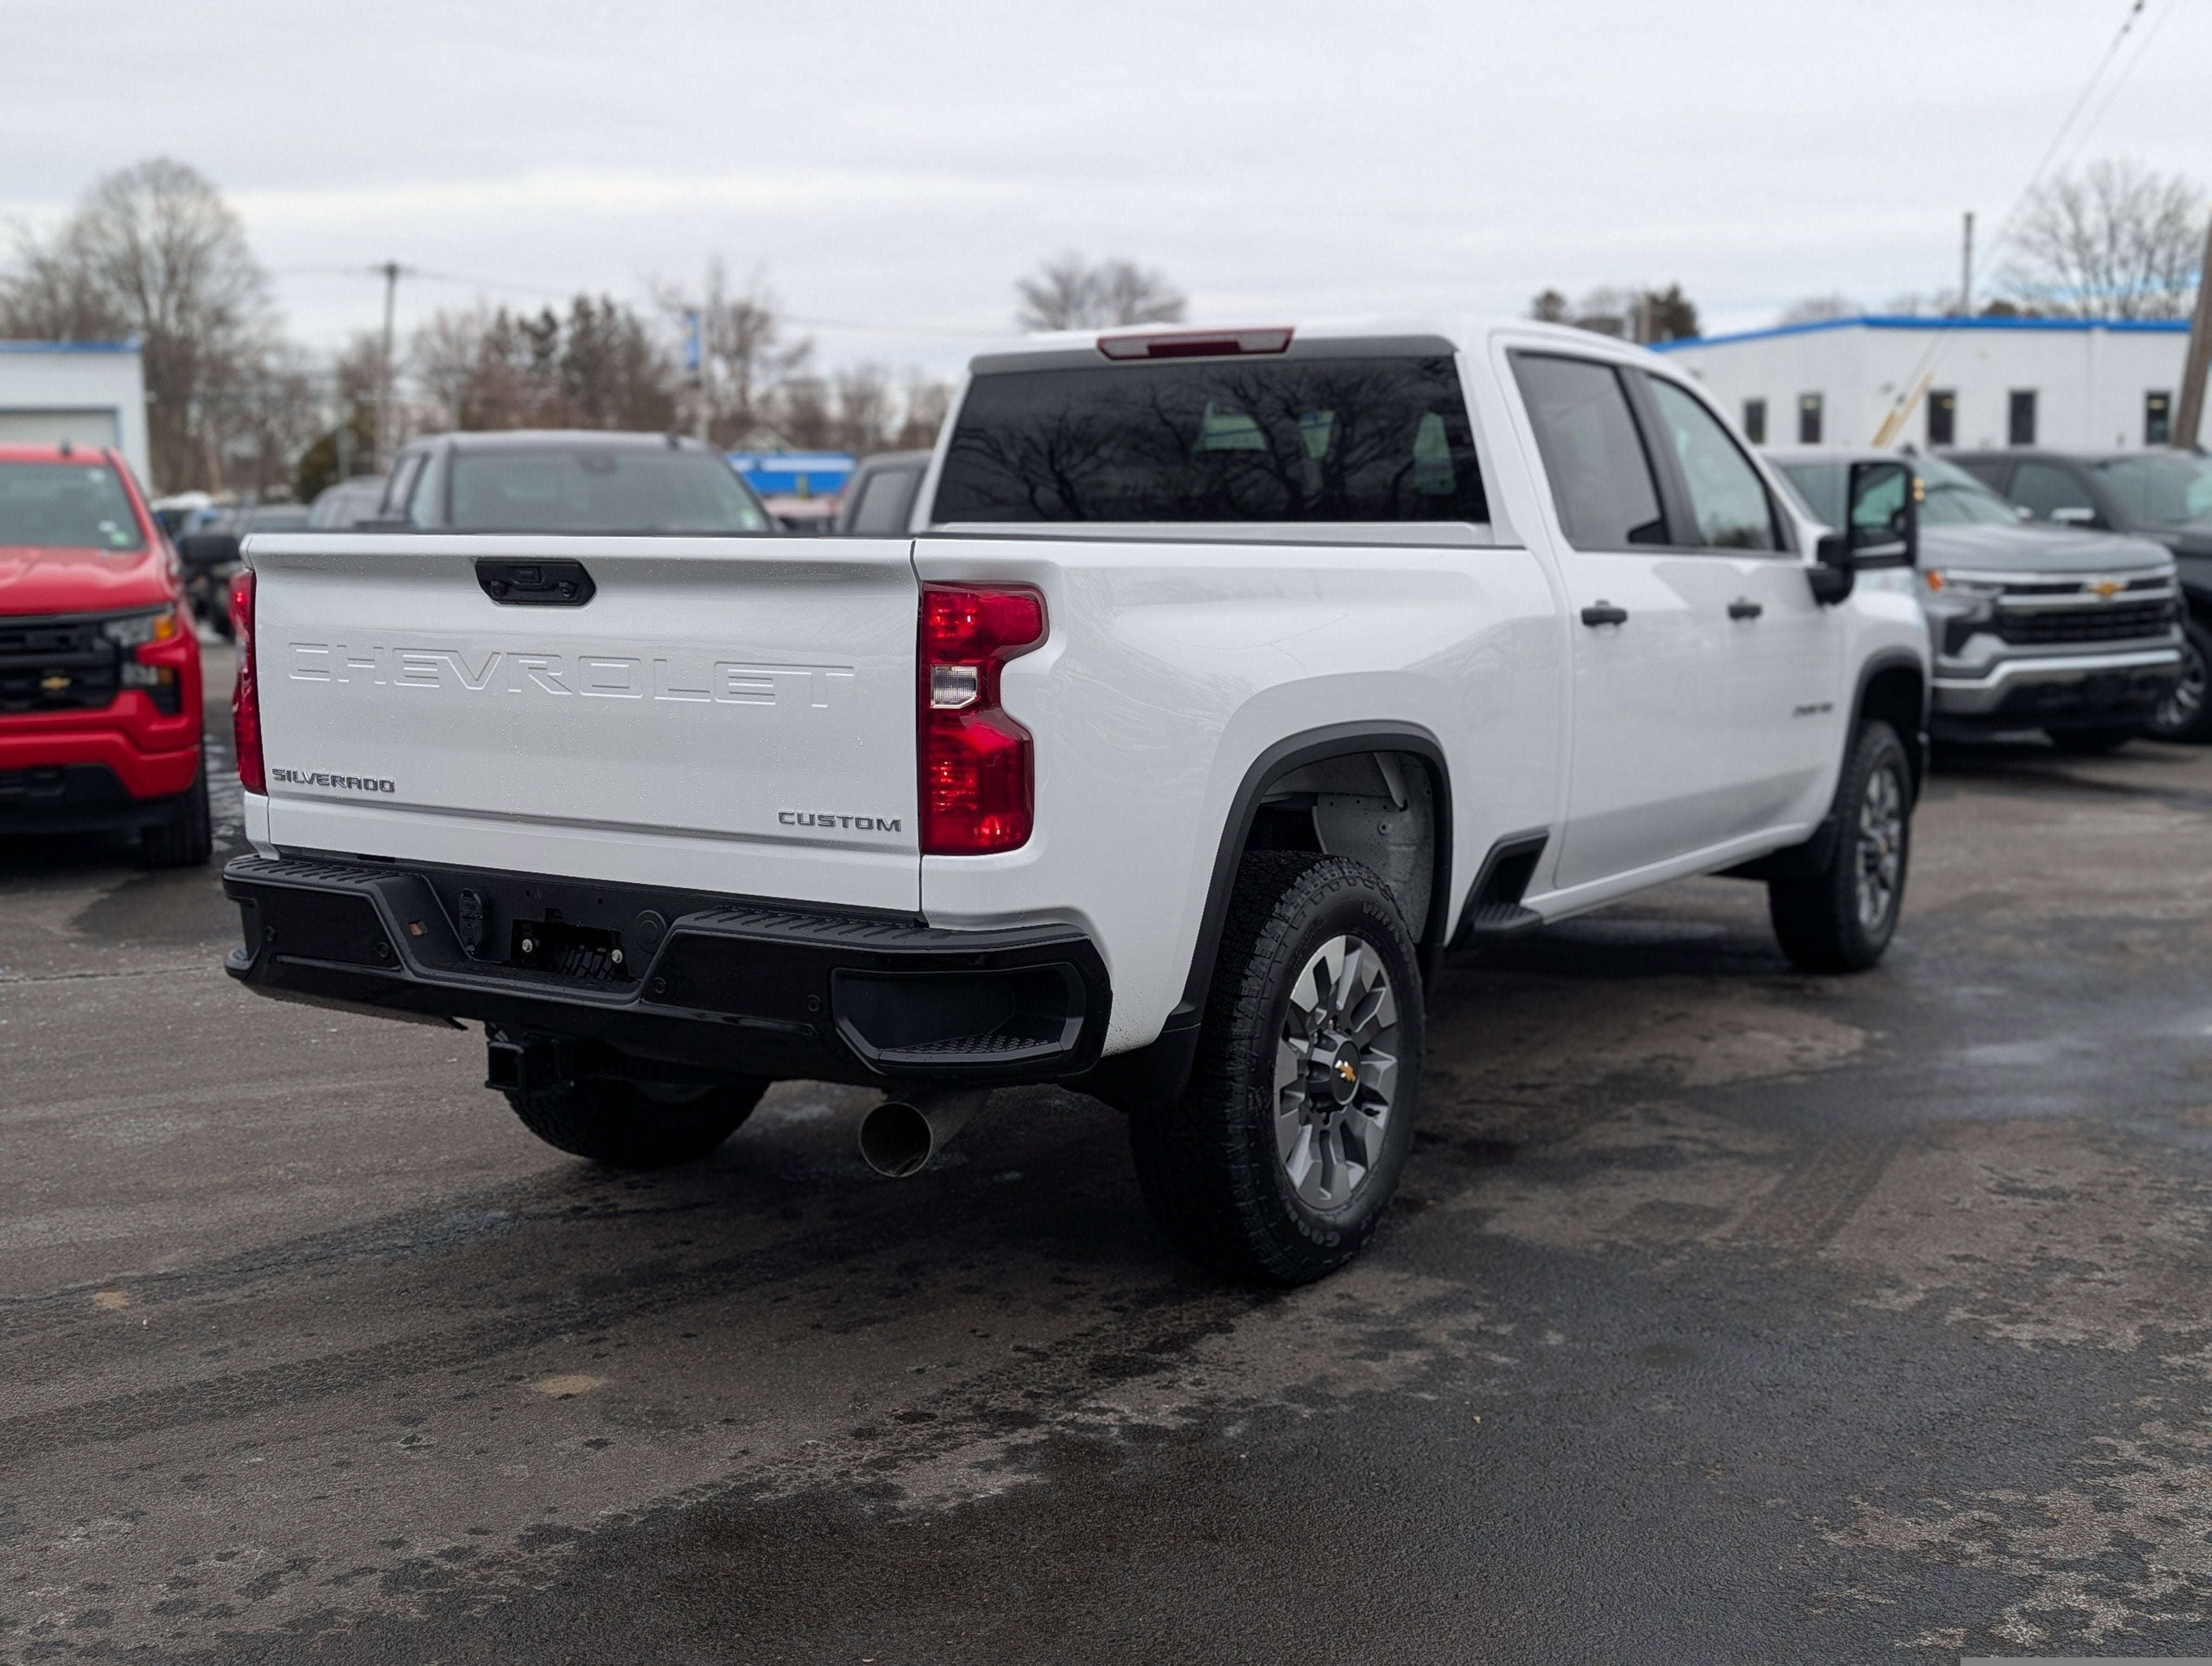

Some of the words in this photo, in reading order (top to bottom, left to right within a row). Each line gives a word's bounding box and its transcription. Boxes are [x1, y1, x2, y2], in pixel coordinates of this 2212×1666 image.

[288, 642, 854, 708] CHEVROLET
[272, 767, 395, 793] SILVERADO
[778, 810, 902, 832] CUSTOM
